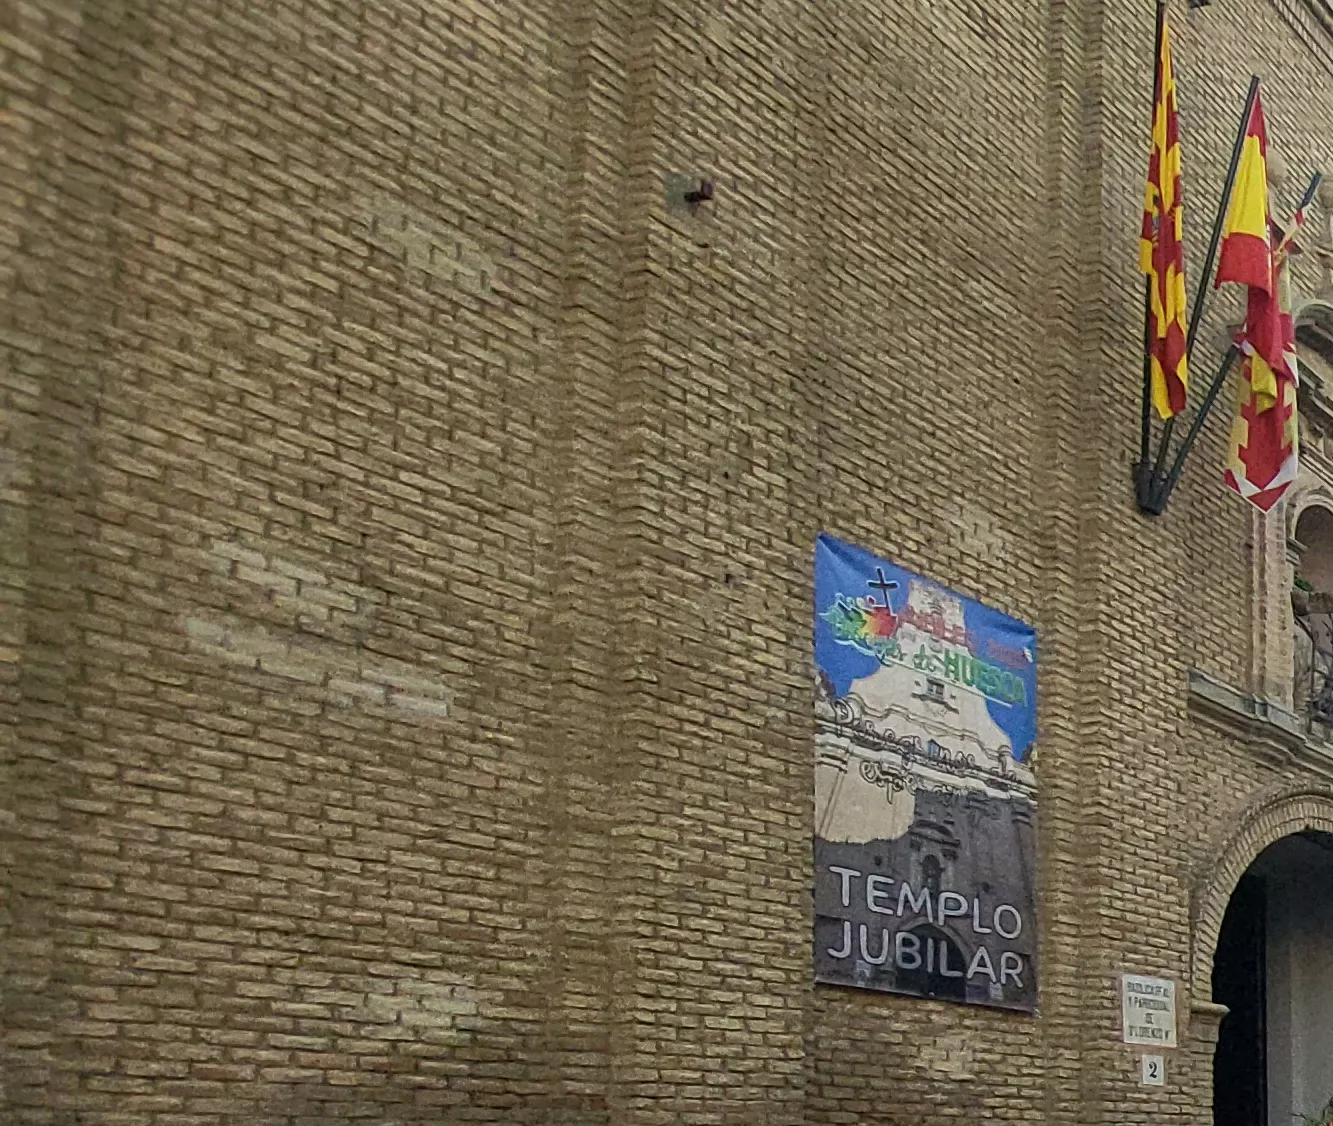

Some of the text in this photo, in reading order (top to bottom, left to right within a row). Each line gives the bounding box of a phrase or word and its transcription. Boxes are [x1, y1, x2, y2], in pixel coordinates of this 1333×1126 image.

[944, 648, 1027, 707] HUESCA
[829, 866, 1022, 939] TEMPLO
[827, 921, 1024, 988] JUBILAR
[1148, 1061, 1158, 1079] 2
